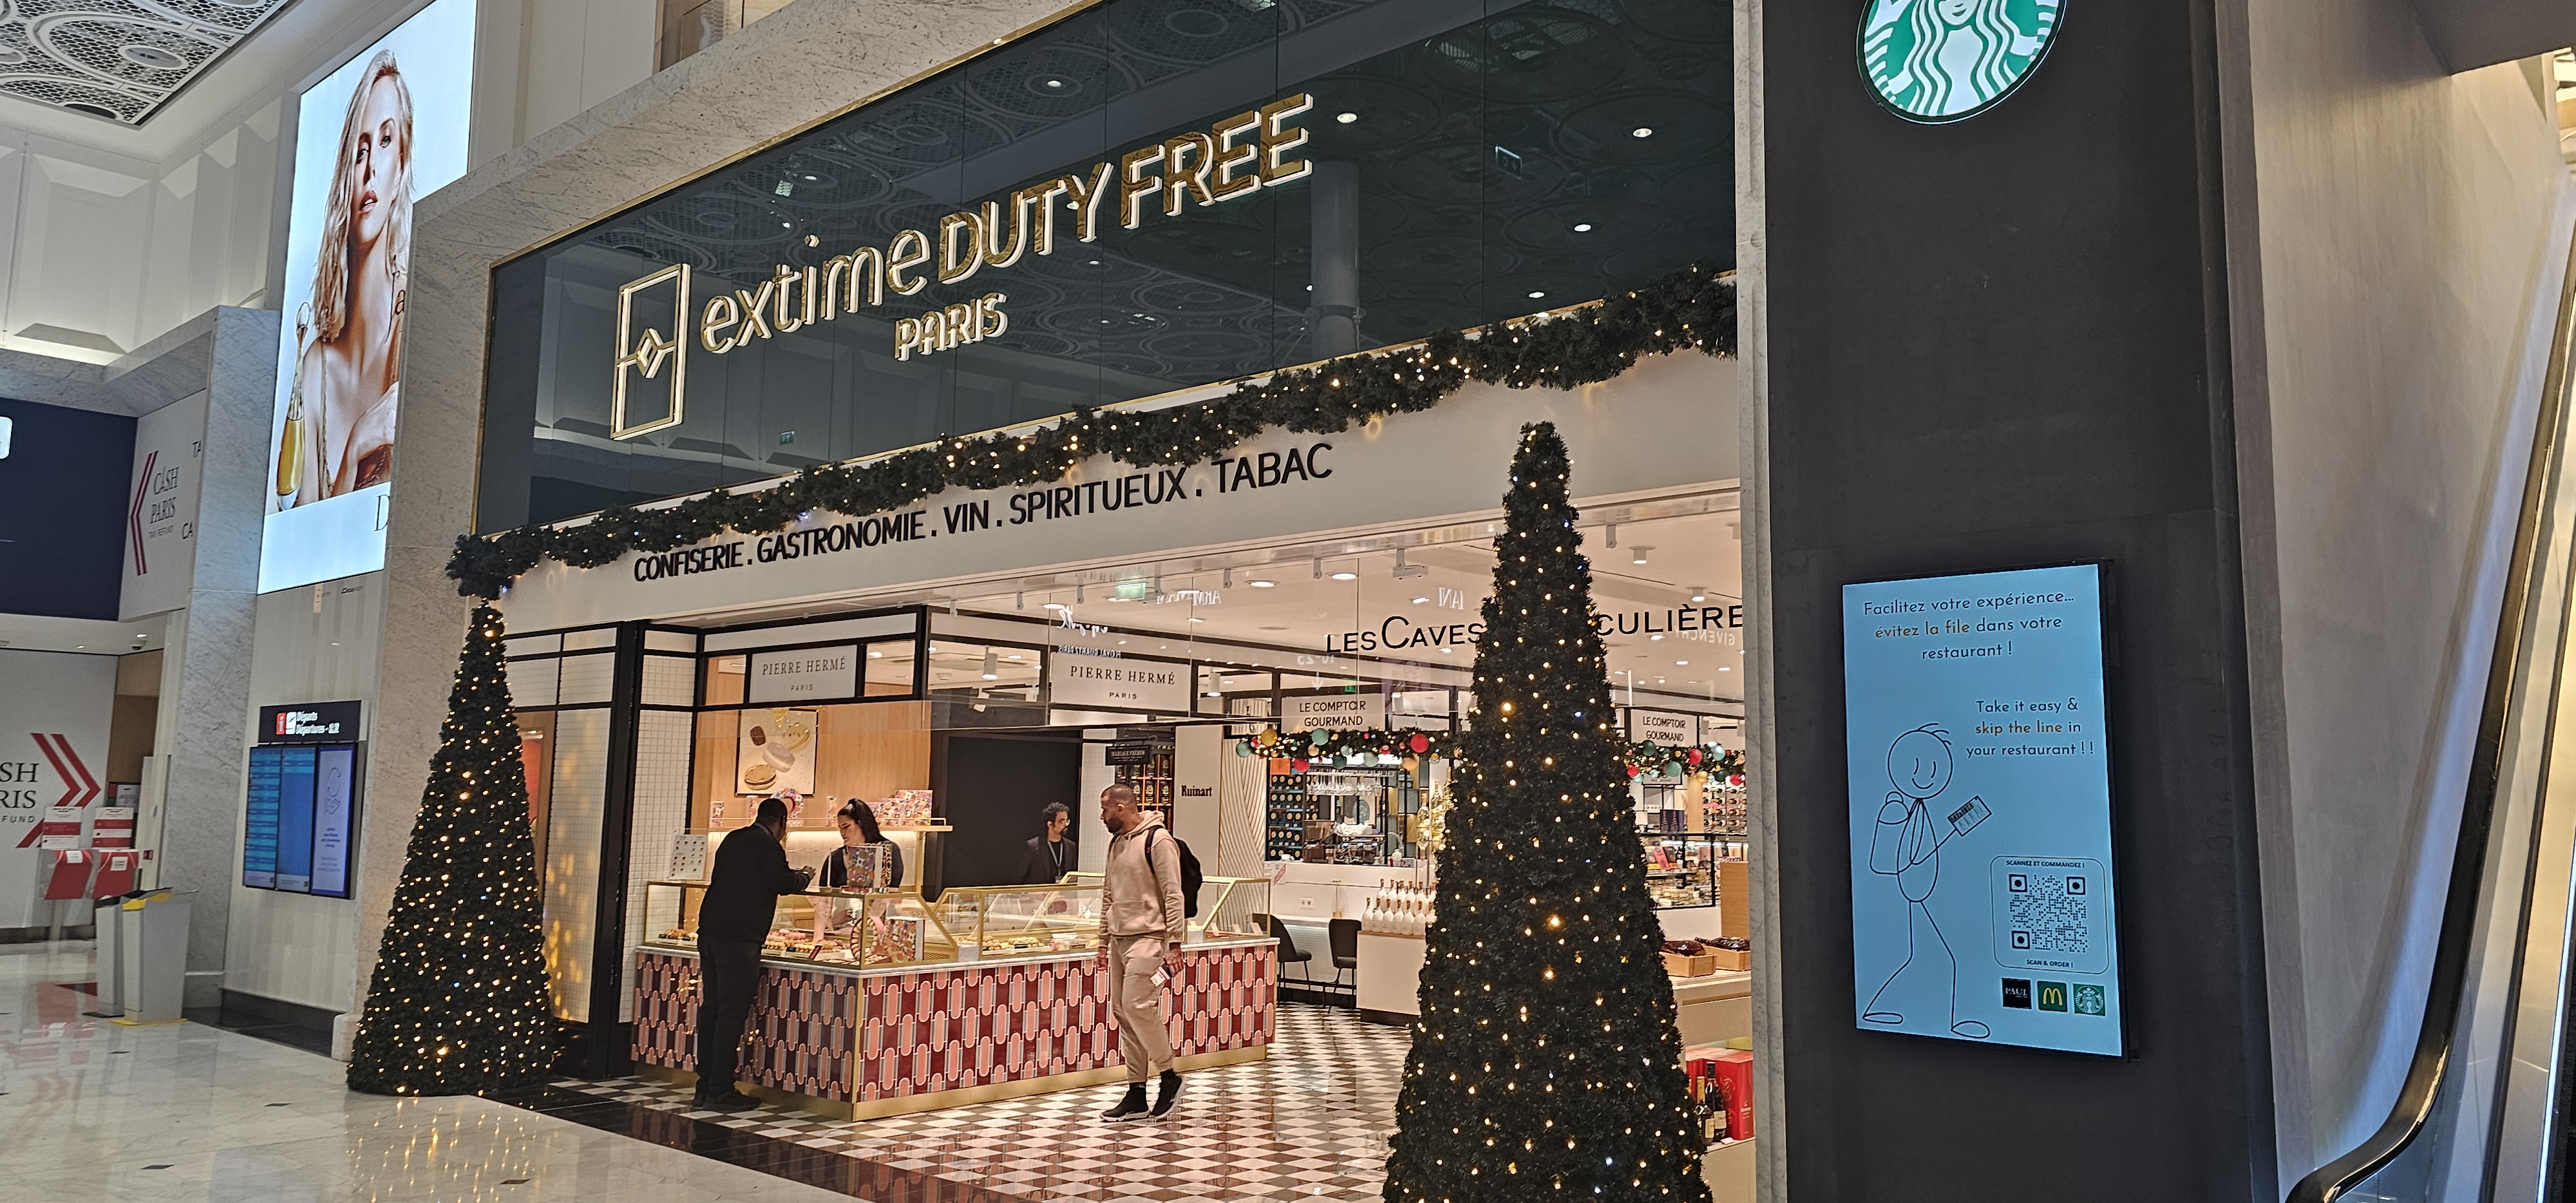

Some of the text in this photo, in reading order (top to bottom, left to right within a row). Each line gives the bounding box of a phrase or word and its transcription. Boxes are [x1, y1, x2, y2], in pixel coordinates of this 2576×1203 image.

[701, 93, 1313, 354] extime DUTY FREE
[895, 292, 1008, 361] PARIS
[634, 541, 744, 582] CONFISERIE
[757, 511, 926, 564] GASTRONOMIE
[943, 500, 989, 534] VIN
[1010, 464, 1187, 525] SPIRITUEUX
[1211, 442, 1333, 493] TABAC
[1864, 591, 2074, 616] Facilitez votre expérience...
[1326, 616, 1488, 653] LES CAVES
[1875, 616, 2062, 639] évitez la file dans votre
[1922, 643, 2003, 660] restaurant
[762, 656, 846, 676] PIERRE HERMÉ
[1070, 666, 1175, 685] PIERRE HERMÉ
[1109, 692, 1137, 700] PARIS
[1300, 701, 1366, 712] LE COMPTOIR
[1976, 697, 2079, 714] Take it easy &
[1304, 715, 1363, 726] GOURMAND
[1643, 716, 1686, 728] LE COMPTOIR
[1975, 721, 2081, 736] skip the line in
[1646, 730, 1684, 741] GOURMAND
[1966, 746, 1996, 759] your
[2001, 743, 2077, 756] restaurant
[1181, 785, 1212, 797] Ruinart
[2005, 987, 2029, 996] PAUL
